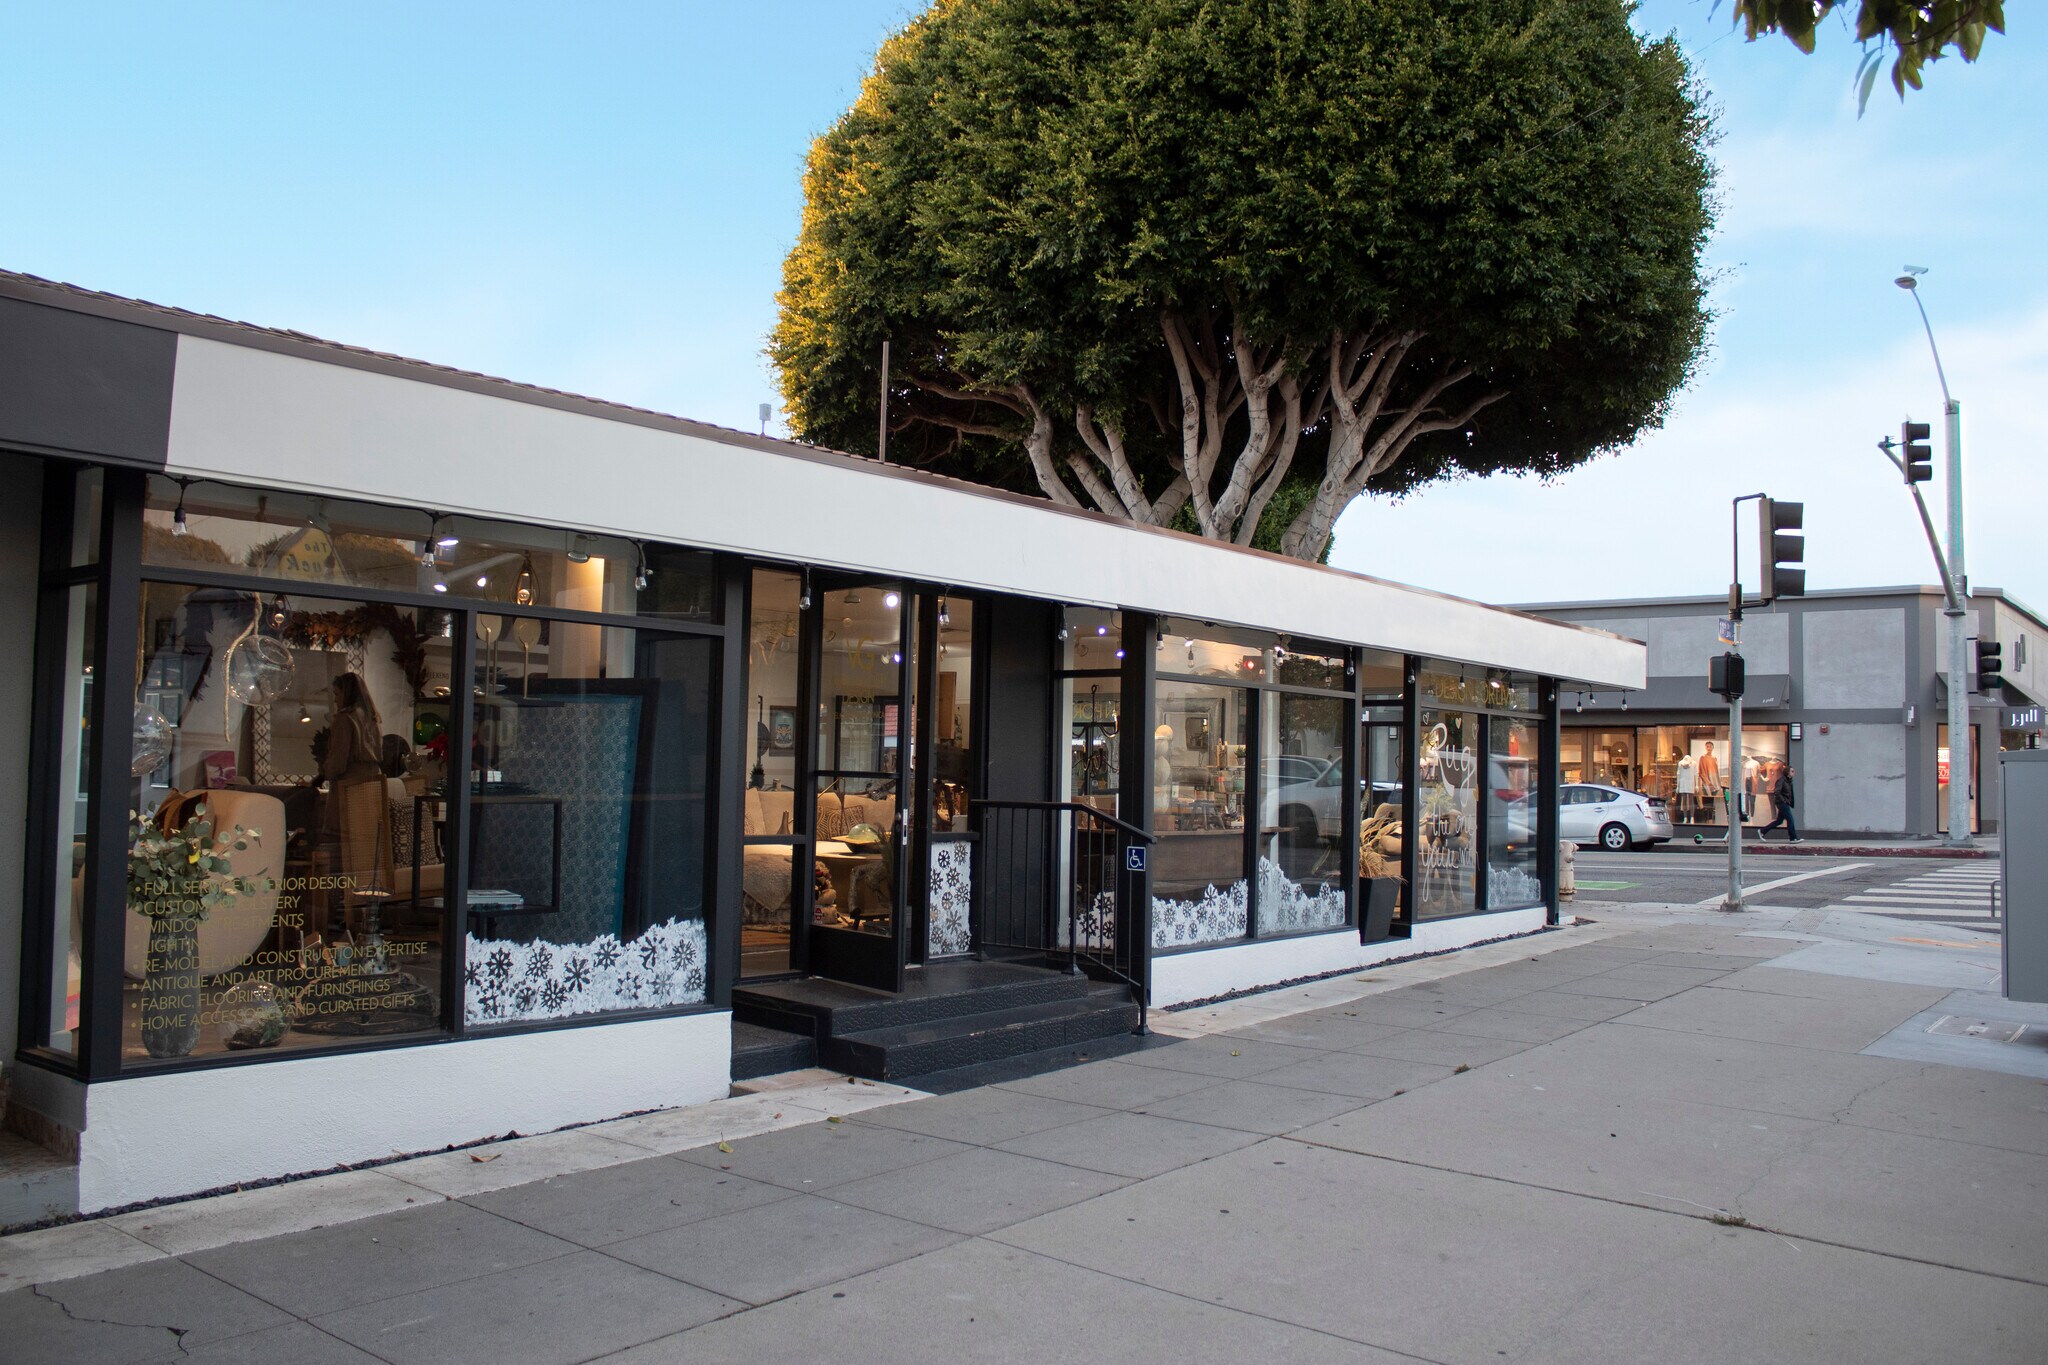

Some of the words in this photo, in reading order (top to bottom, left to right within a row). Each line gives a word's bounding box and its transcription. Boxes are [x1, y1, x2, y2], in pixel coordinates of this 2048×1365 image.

[1435, 682, 1473, 702] DESIGN
[1430, 722, 1475, 807] Rug
[1430, 801, 1451, 836] the
[144, 881, 180, 895] FULL
[244, 877, 306, 892] INTERIOR
[309, 875, 357, 890] DESIGN
[144, 899, 208, 915] CUSTOM
[213, 895, 301, 910] POLSTERY
[215, 913, 304, 929] TREATMENTS
[143, 955, 218, 973] RE-MODEL
[222, 952, 253, 967] AND
[257, 946, 363, 965] CONSTRUCTION
[366, 942, 428, 958] EXPERTISE
[144, 937, 207, 953] LIGHTIN
[140, 974, 208, 992] ANTIQUE
[212, 972, 243, 987] AND
[247, 969, 274, 983] ART
[277, 963, 374, 981] PROCUREMENT
[141, 994, 194, 1012] FABRIC,
[199, 987, 273, 1008] FLOORING
[275, 986, 304, 1000] AND
[308, 978, 390, 997] FURNISHINGS
[140, 1014, 187, 1031] HOME
[190, 1005, 283, 1026] ACCESSORIES
[286, 1003, 316, 1017] AND
[319, 996, 378, 1014] CURATED
[382, 993, 415, 1009] GIFTS
